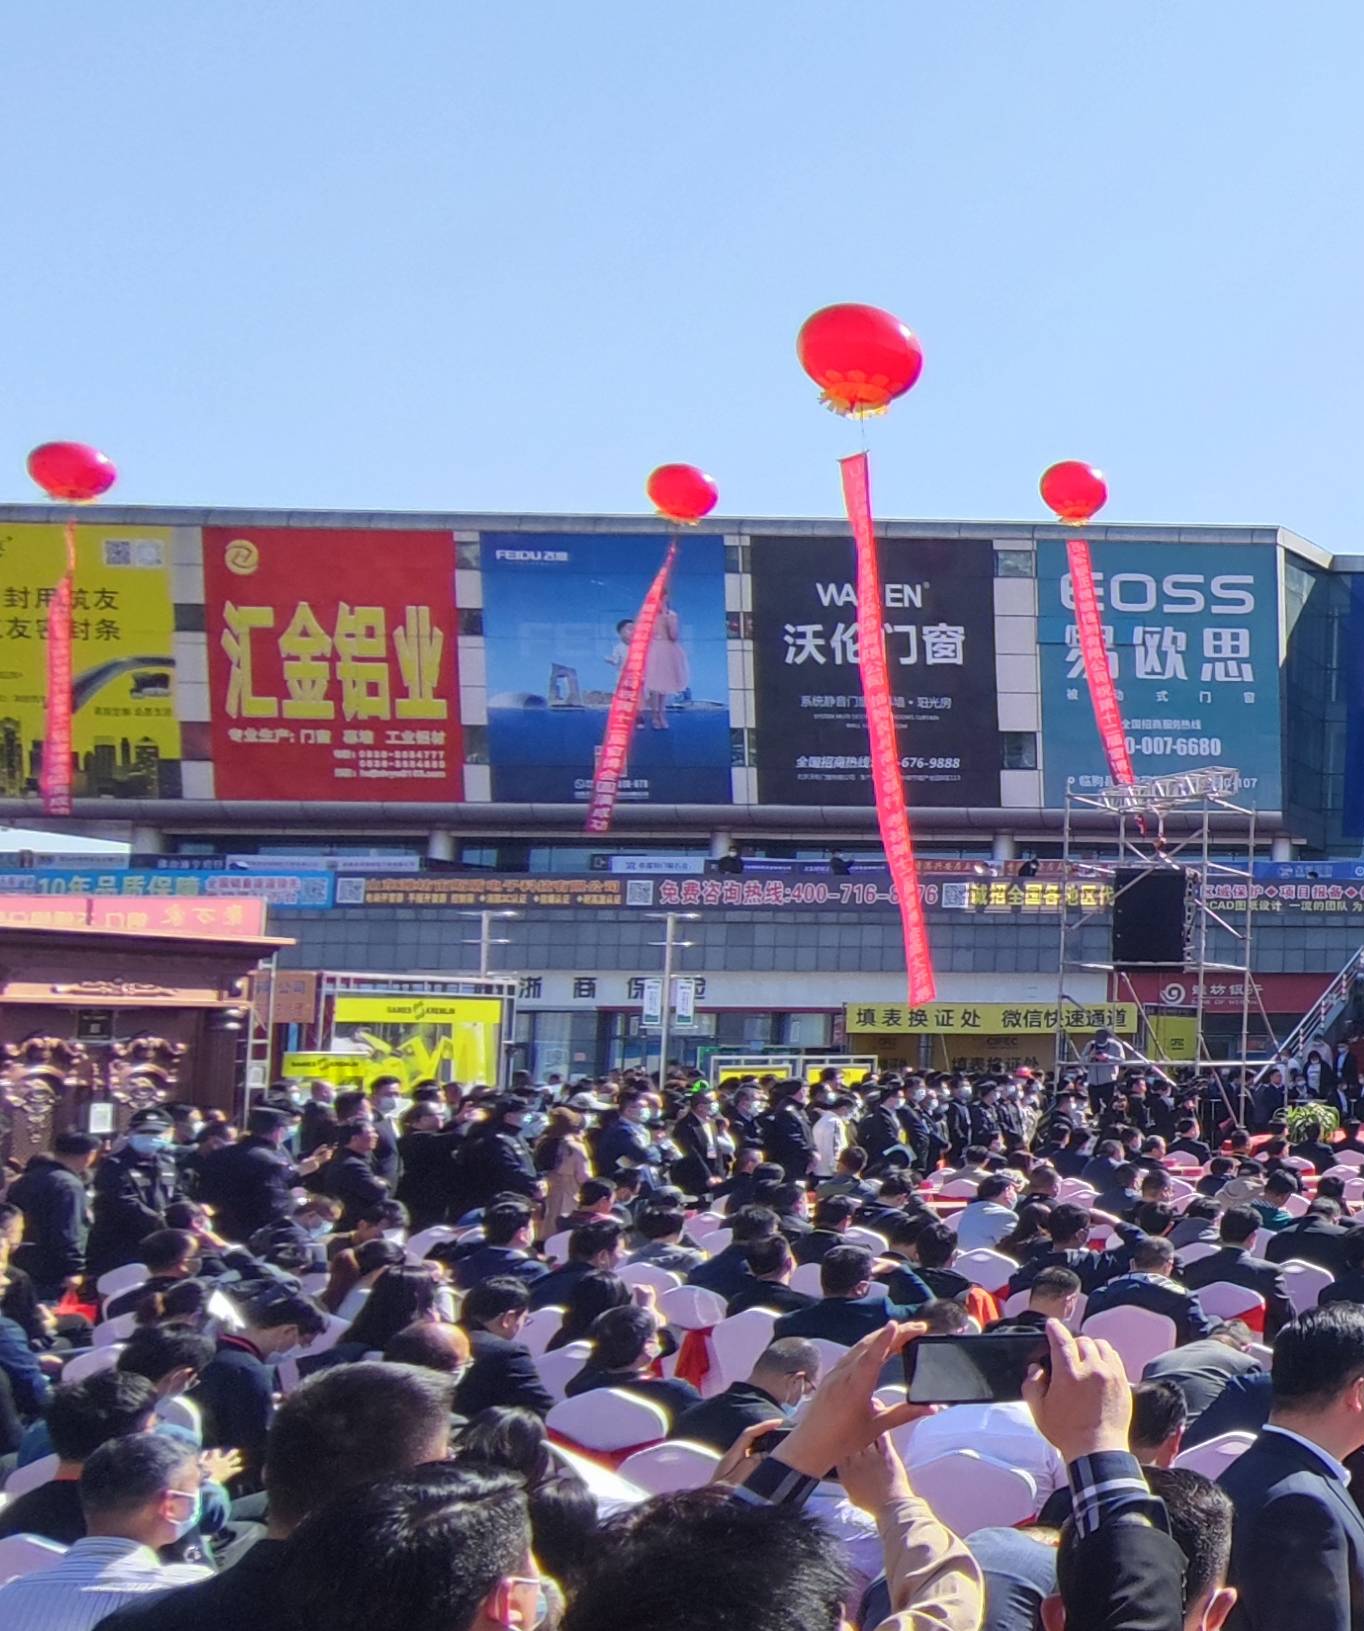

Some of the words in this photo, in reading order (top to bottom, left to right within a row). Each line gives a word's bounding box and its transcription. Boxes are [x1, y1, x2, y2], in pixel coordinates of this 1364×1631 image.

[496, 550, 542, 561] FEIDU
[816, 582, 922, 608] WAEN
[1060, 572, 1254, 614] EOSS
[221, 600, 447, 720] 汇金铝业
[784, 622, 966, 665] 沃伦门窗
[1065, 624, 1254, 682] 易欧思
[1124, 737, 1221, 755] 0-007-6680
[856, 1008, 981, 1028] 填表换证处
[1001, 1008, 1127, 1028] 微信快速通道
